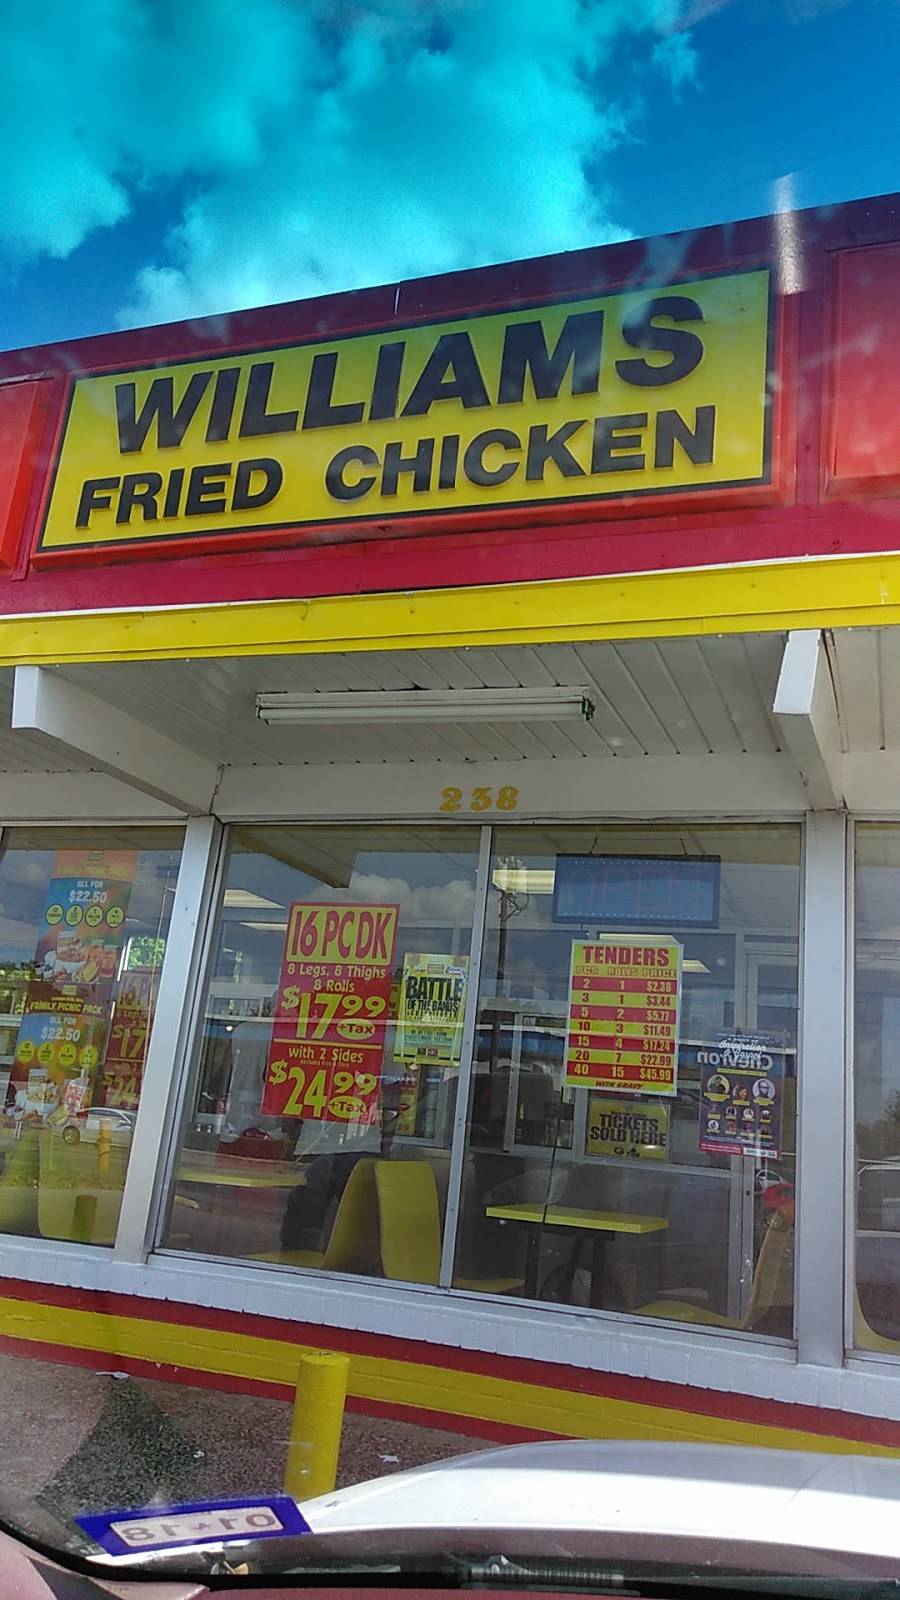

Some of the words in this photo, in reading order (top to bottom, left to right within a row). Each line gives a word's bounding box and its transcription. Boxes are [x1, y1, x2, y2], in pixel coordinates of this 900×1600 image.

[114, 295, 705, 455] WILLIAMS
[74, 457, 283, 529] FRIED
[325, 405, 716, 502] CHICKEN
[437, 785, 520, 813] 238
[68, 889, 108, 904] $22.50
[290, 910, 320, 957] 16
[583, 945, 670, 967] TENDERS
[287, 963, 296, 975] 8
[334, 965, 343, 977] 8
[347, 966, 387, 981] Thighs
[641, 968, 677, 979] PRICE
[313, 979, 322, 991] 8
[326, 979, 356, 993] Rolls
[405, 976, 464, 1001] BATTLE
[583, 978, 591, 989] 2
[619, 980, 625, 991] 1
[582, 992, 590, 1003] 3
[618, 994, 625, 1005] 1
[645, 995, 671, 1007] $3.44
[581, 1007, 589, 1018] 5
[616, 1008, 625, 1019] 2
[646, 1010, 670, 1022] $5.77
[41, 1025, 81, 1042] $22.50
[578, 1021, 591, 1032] 10
[615, 1023, 624, 1034] 3
[643, 1024, 671, 1036] $11.49
[577, 1035, 590, 1047] 15
[642, 1040, 671, 1052] $17.24
[288, 1046, 314, 1060] with
[319, 1049, 327, 1060] 2
[331, 1048, 364, 1064] Sides
[615, 1052, 622, 1063] 7
[640, 1053, 672, 1067] $22.99
[574, 1063, 589, 1075] 40
[610, 1065, 625, 1077] 15
[639, 1068, 671, 1081] $45.99
[599, 1113, 658, 1131] TICKETS
[590, 1126, 627, 1142] SOLD
[629, 1130, 666, 1146] HERE
